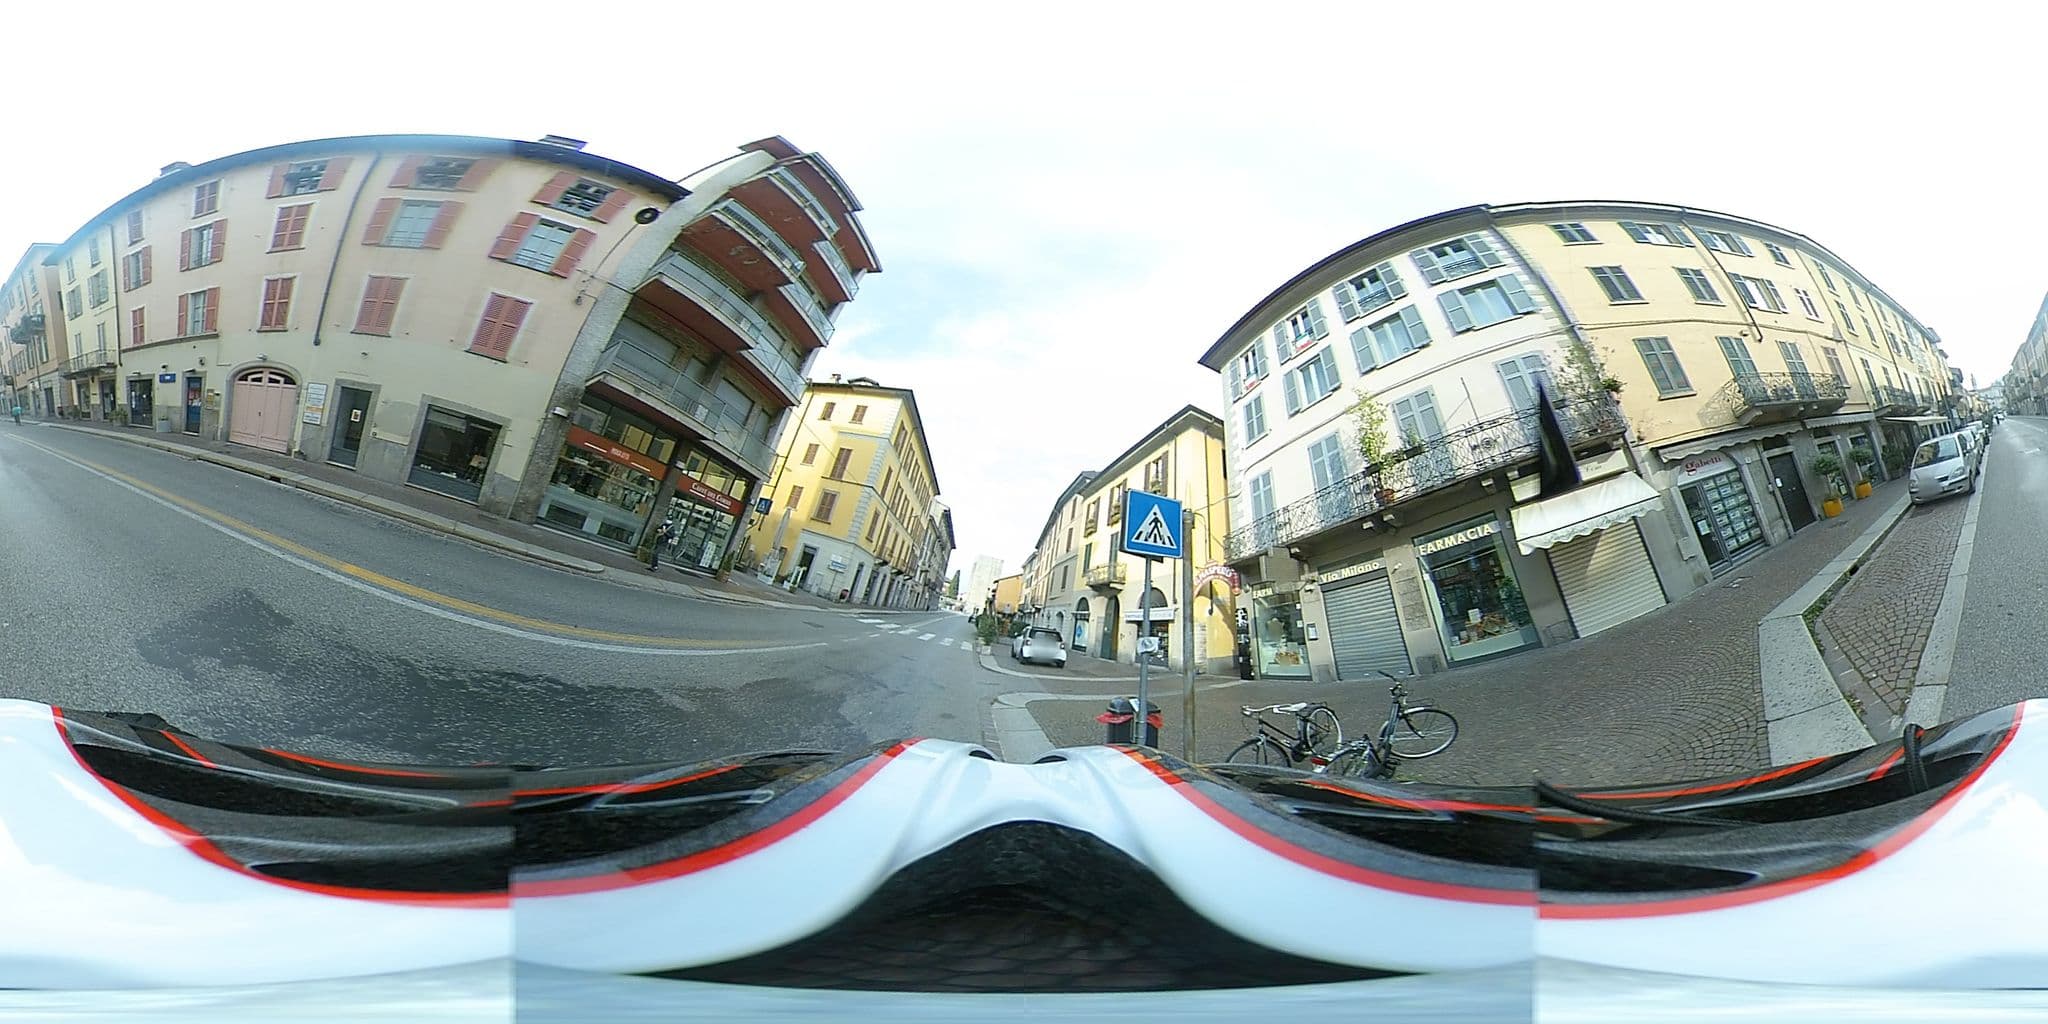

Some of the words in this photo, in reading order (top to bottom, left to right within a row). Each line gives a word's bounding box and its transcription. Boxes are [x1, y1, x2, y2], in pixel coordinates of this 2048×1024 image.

[1419, 523, 1493, 556] FARMACIA
[1320, 572, 1338, 582] Via
[1341, 561, 1380, 579] Milano
